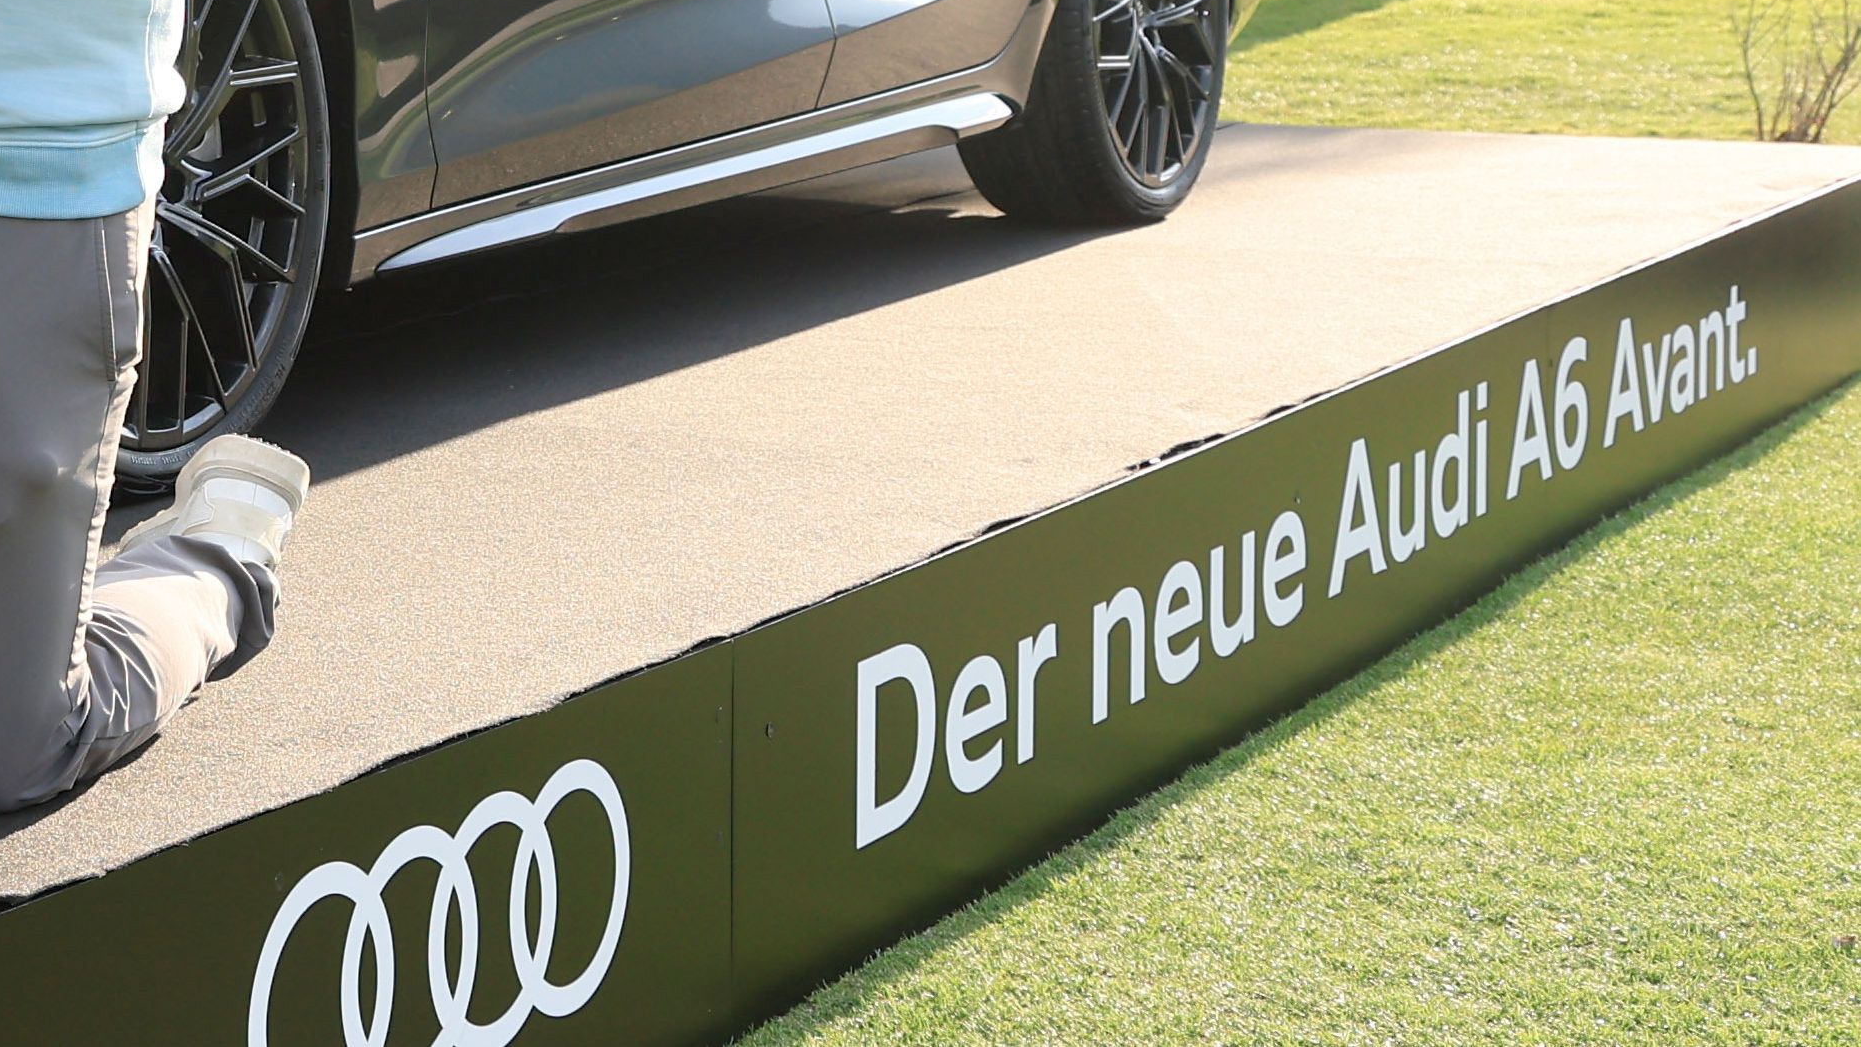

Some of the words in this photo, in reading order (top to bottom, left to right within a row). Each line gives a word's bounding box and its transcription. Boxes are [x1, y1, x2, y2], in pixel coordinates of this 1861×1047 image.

[856, 623, 1057, 850] Der
[1092, 511, 1307, 725] neue
[1328, 381, 1488, 598] Audi
[1506, 336, 1589, 500] A6
[1604, 285, 1758, 449] Avant.
